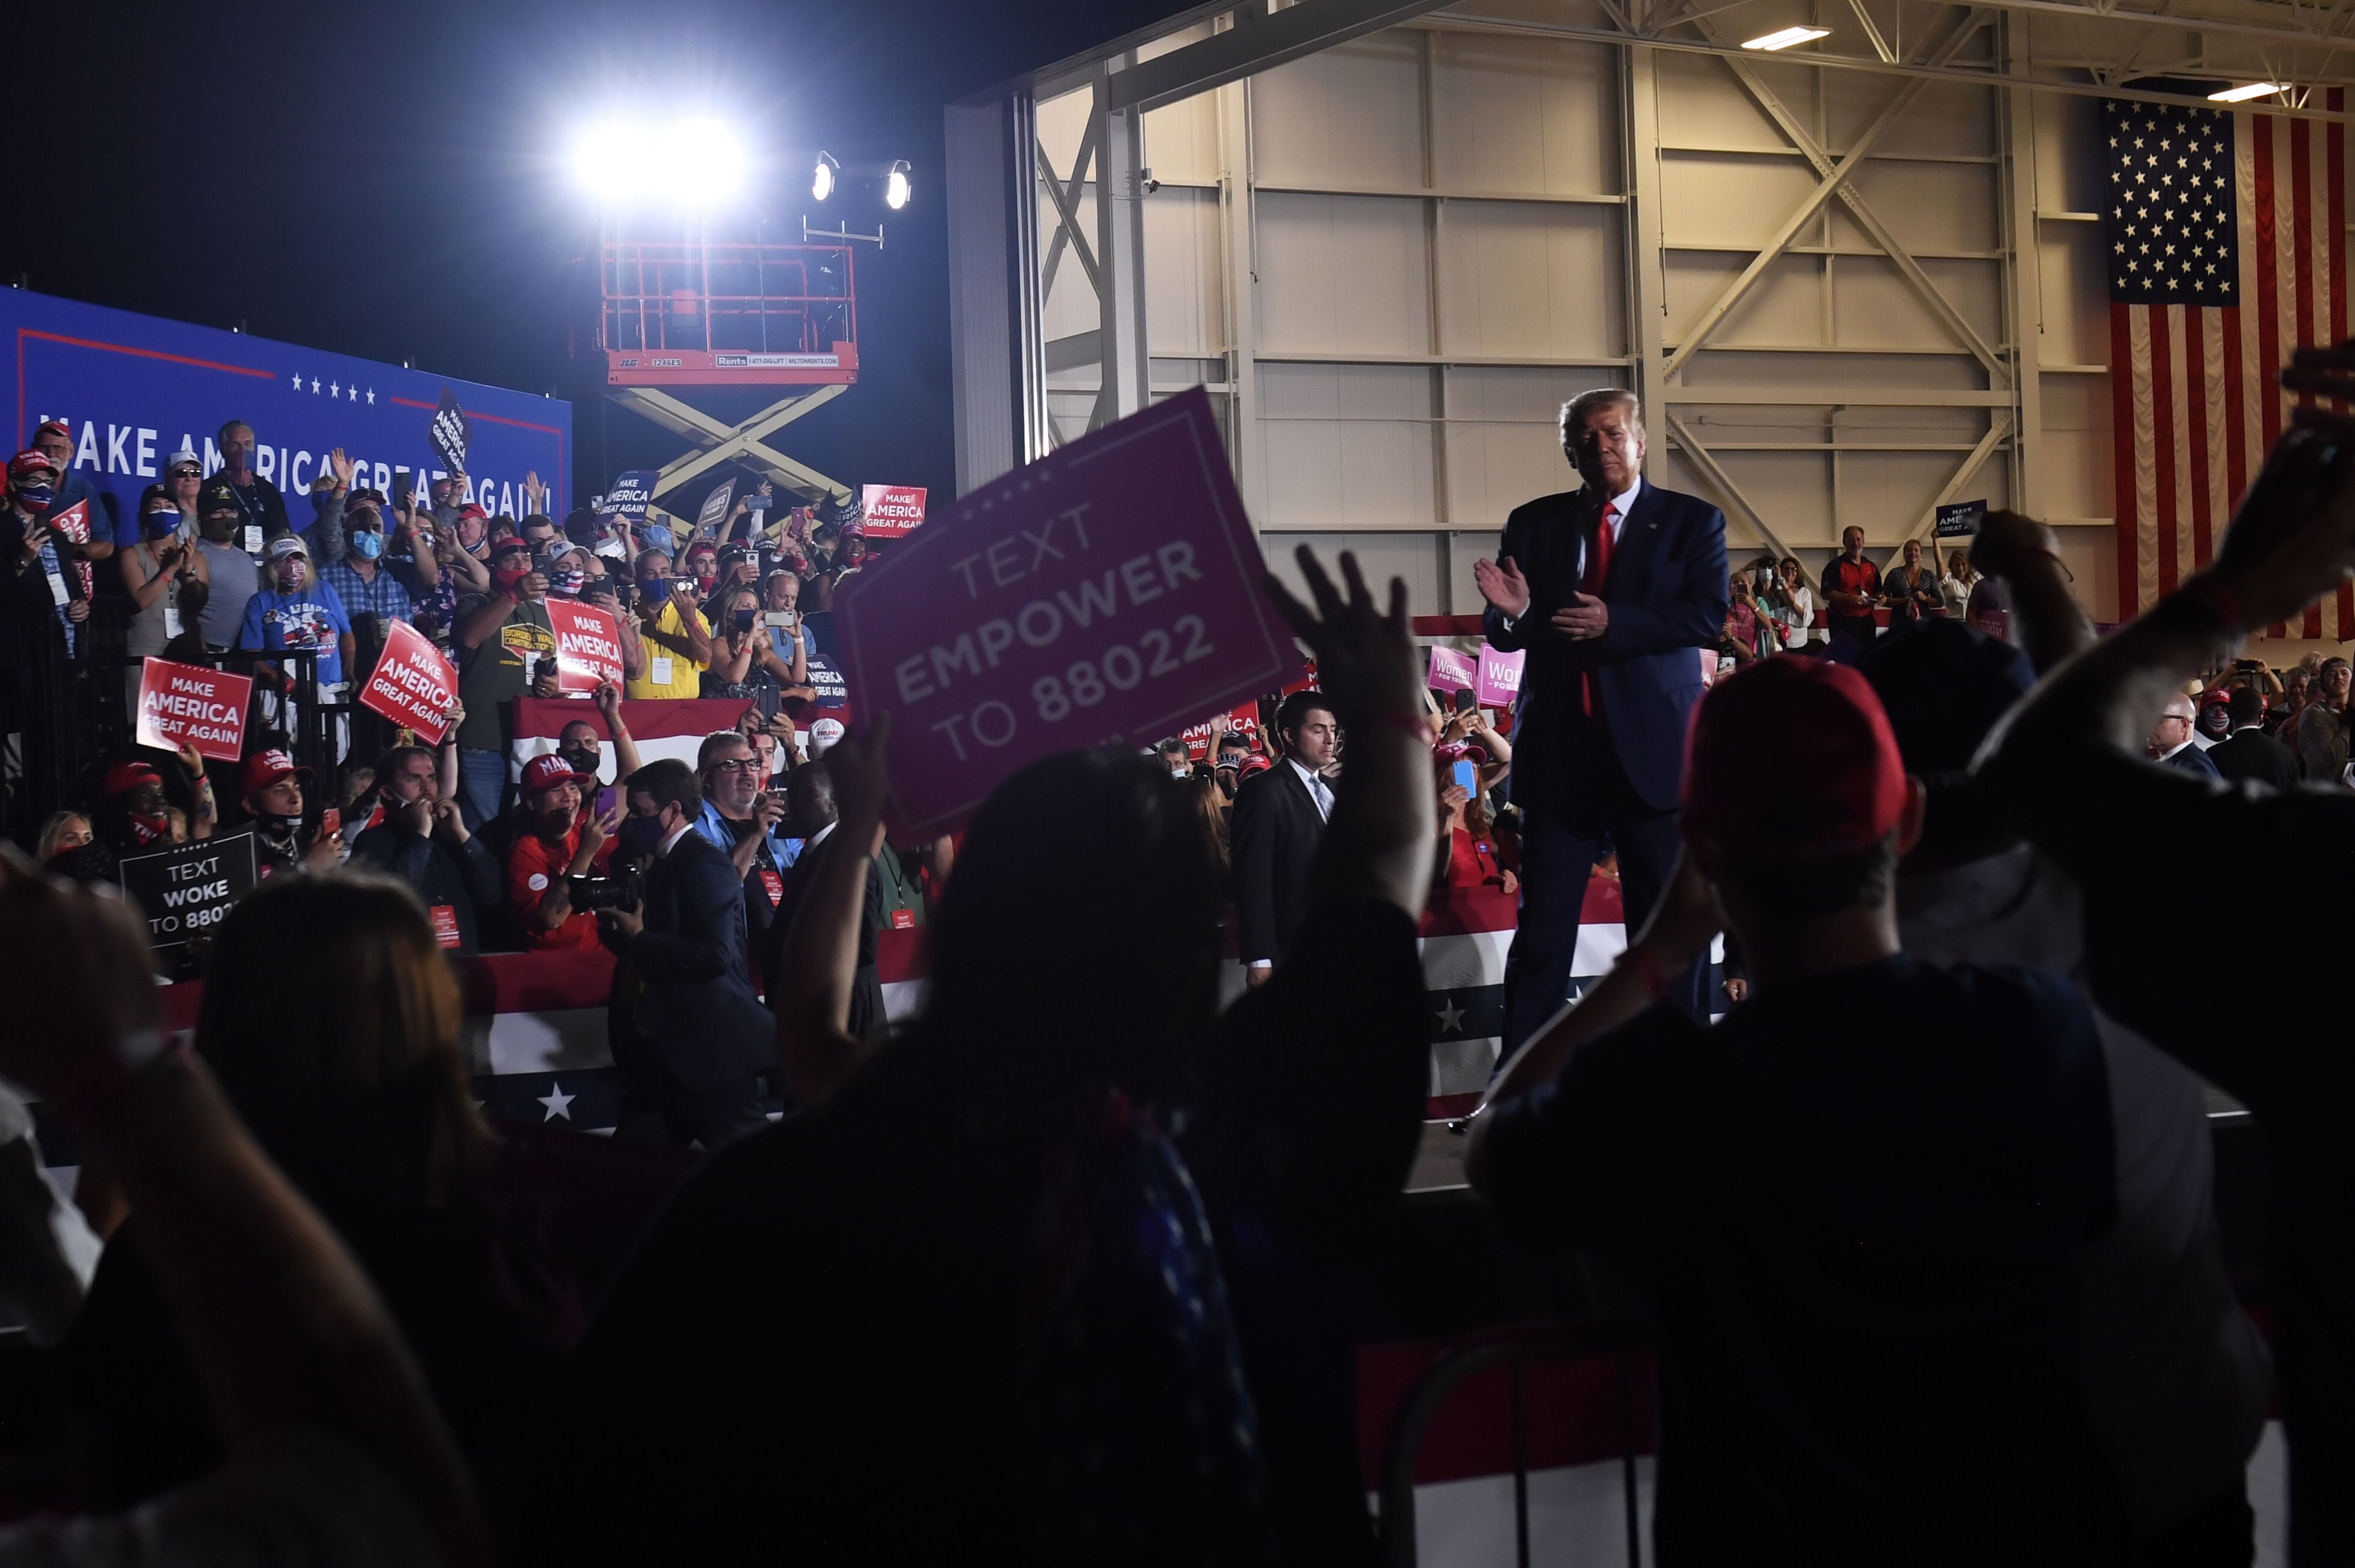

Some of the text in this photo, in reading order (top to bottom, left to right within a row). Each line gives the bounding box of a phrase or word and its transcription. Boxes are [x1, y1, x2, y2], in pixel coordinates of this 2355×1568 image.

[718, 356, 747, 365] Rents
[450, 409, 464, 435] MAKE
[433, 424, 451, 451] GREAT
[436, 411, 466, 463] AMERICA
[40, 415, 158, 477] AKE
[351, 460, 448, 510] GRA
[461, 475, 550, 523] AGAI!
[618, 479, 639, 488] MAKE
[619, 504, 646, 513] AGAIN
[839, 503, 854, 514] AKE
[867, 504, 923, 518] AMERICA
[885, 494, 910, 503] MAKE
[867, 519, 896, 528] GREAT
[951, 502, 1092, 599] TEXT
[573, 615, 603, 634] MAKE
[894, 540, 1203, 706] EMPOWER
[561, 632, 622, 664] AMERICA
[409, 651, 442, 680] MAKE
[564, 657, 601, 674] REAT
[807, 661, 827, 669] MAKE
[807, 671, 845, 684] AMERICA
[1436, 658, 1473, 682] Women
[172, 677, 215, 697] MAKE
[380, 658, 454, 708] AMERICA
[932, 613, 1215, 762] TO 88022
[143, 690, 239, 726] AMERICA
[373, 678, 446, 729] GREAT AGAIN
[145, 714, 238, 744] GREAT AGAIN
[1182, 718, 1256, 739] AMICA
[166, 856, 221, 882] TEXT
[163, 879, 230, 908] WOKE
[148, 899, 240, 934] TO 8802
